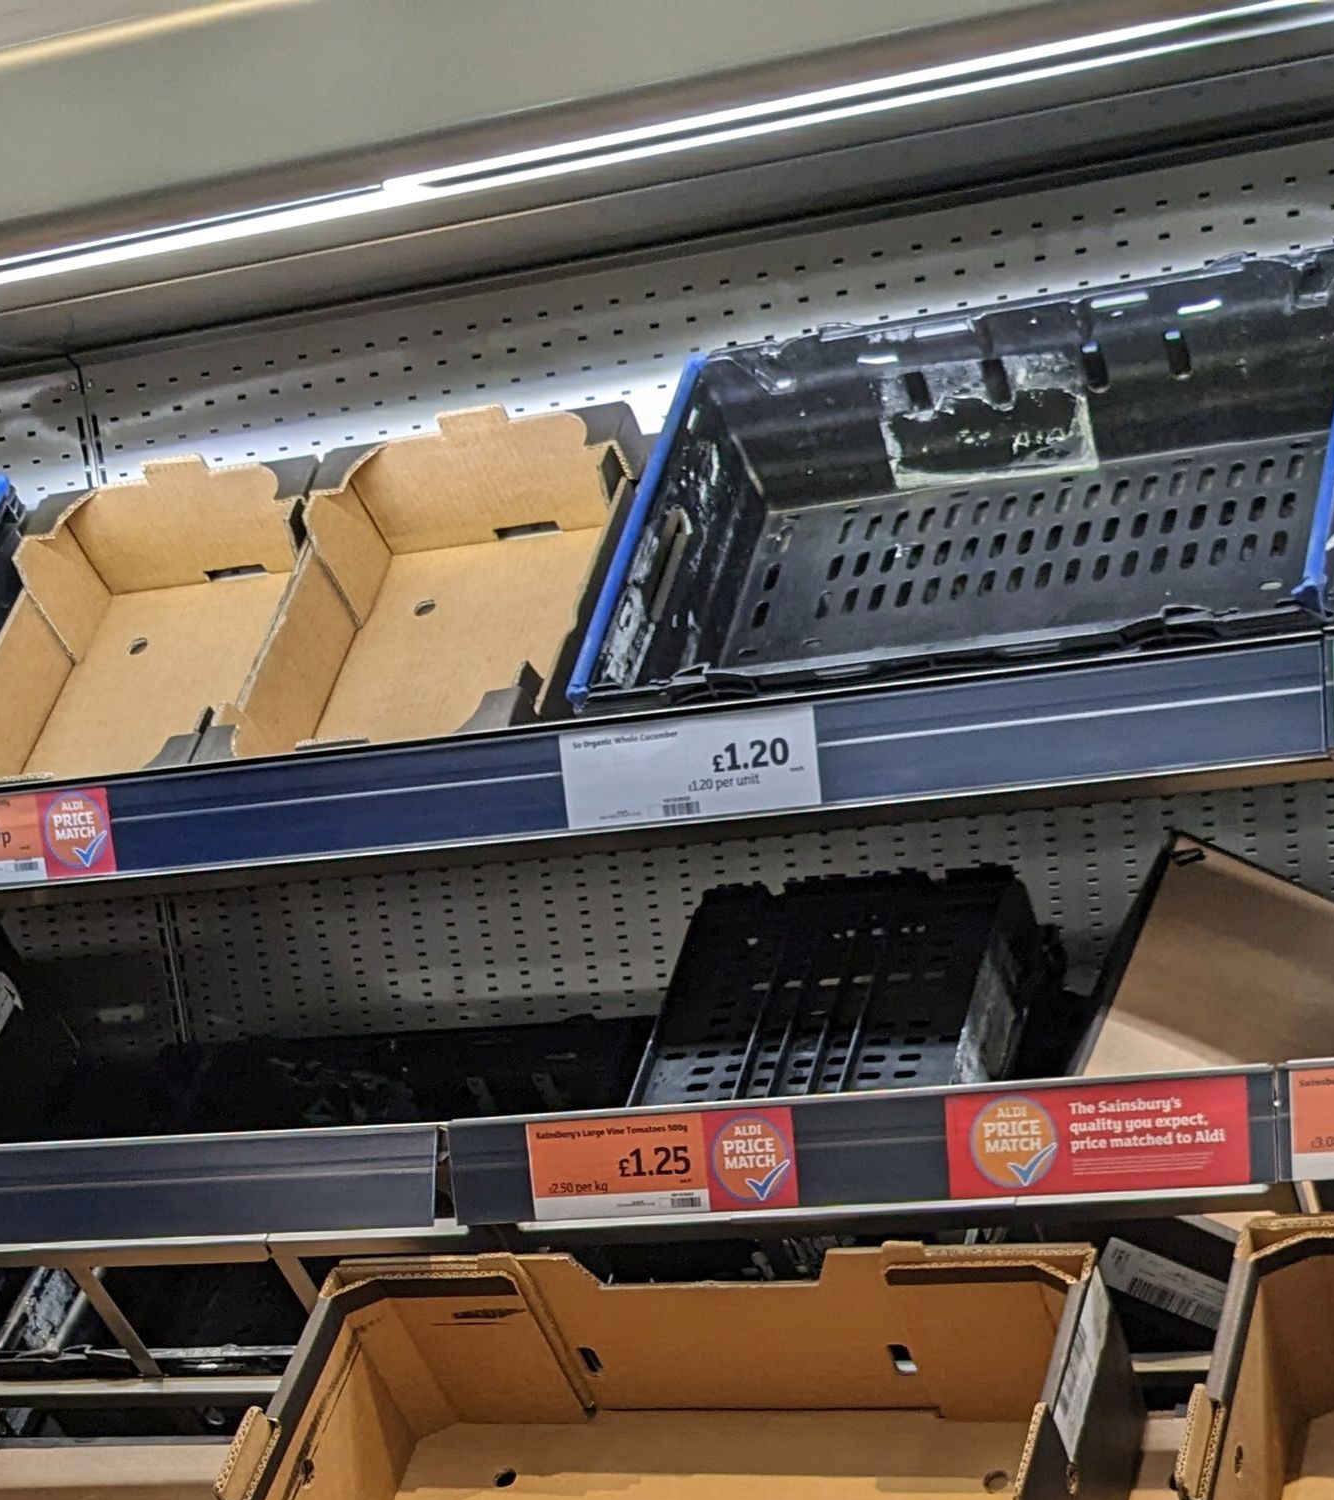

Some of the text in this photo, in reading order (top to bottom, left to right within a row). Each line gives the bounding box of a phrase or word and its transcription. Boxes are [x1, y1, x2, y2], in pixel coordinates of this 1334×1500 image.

[583, 738, 612, 749] Organic
[640, 730, 678, 741] Cucumber
[712, 737, 789, 773] £1.20
[716, 774, 760, 791] per unit
[62, 801, 84, 811] ALDI
[52, 812, 94, 827] PRICE
[55, 827, 95, 840] MATCH
[997, 1107, 1027, 1117] ALDI
[1069, 1097, 1182, 1115] The Sainsbury's
[627, 1125, 666, 1135] Tomatoes
[734, 1125, 761, 1136] ALDI
[983, 1120, 1041, 1137] PRICE
[1070, 1114, 1209, 1134] quality you expect,
[723, 1137, 775, 1154] PRICE
[985, 1138, 1041, 1153] MATCH
[1070, 1129, 1225, 1154] price matched to Aldi
[618, 1146, 691, 1177] £1.25
[724, 1155, 776, 1169] MATCH
[576, 1180, 608, 1194] per kg
